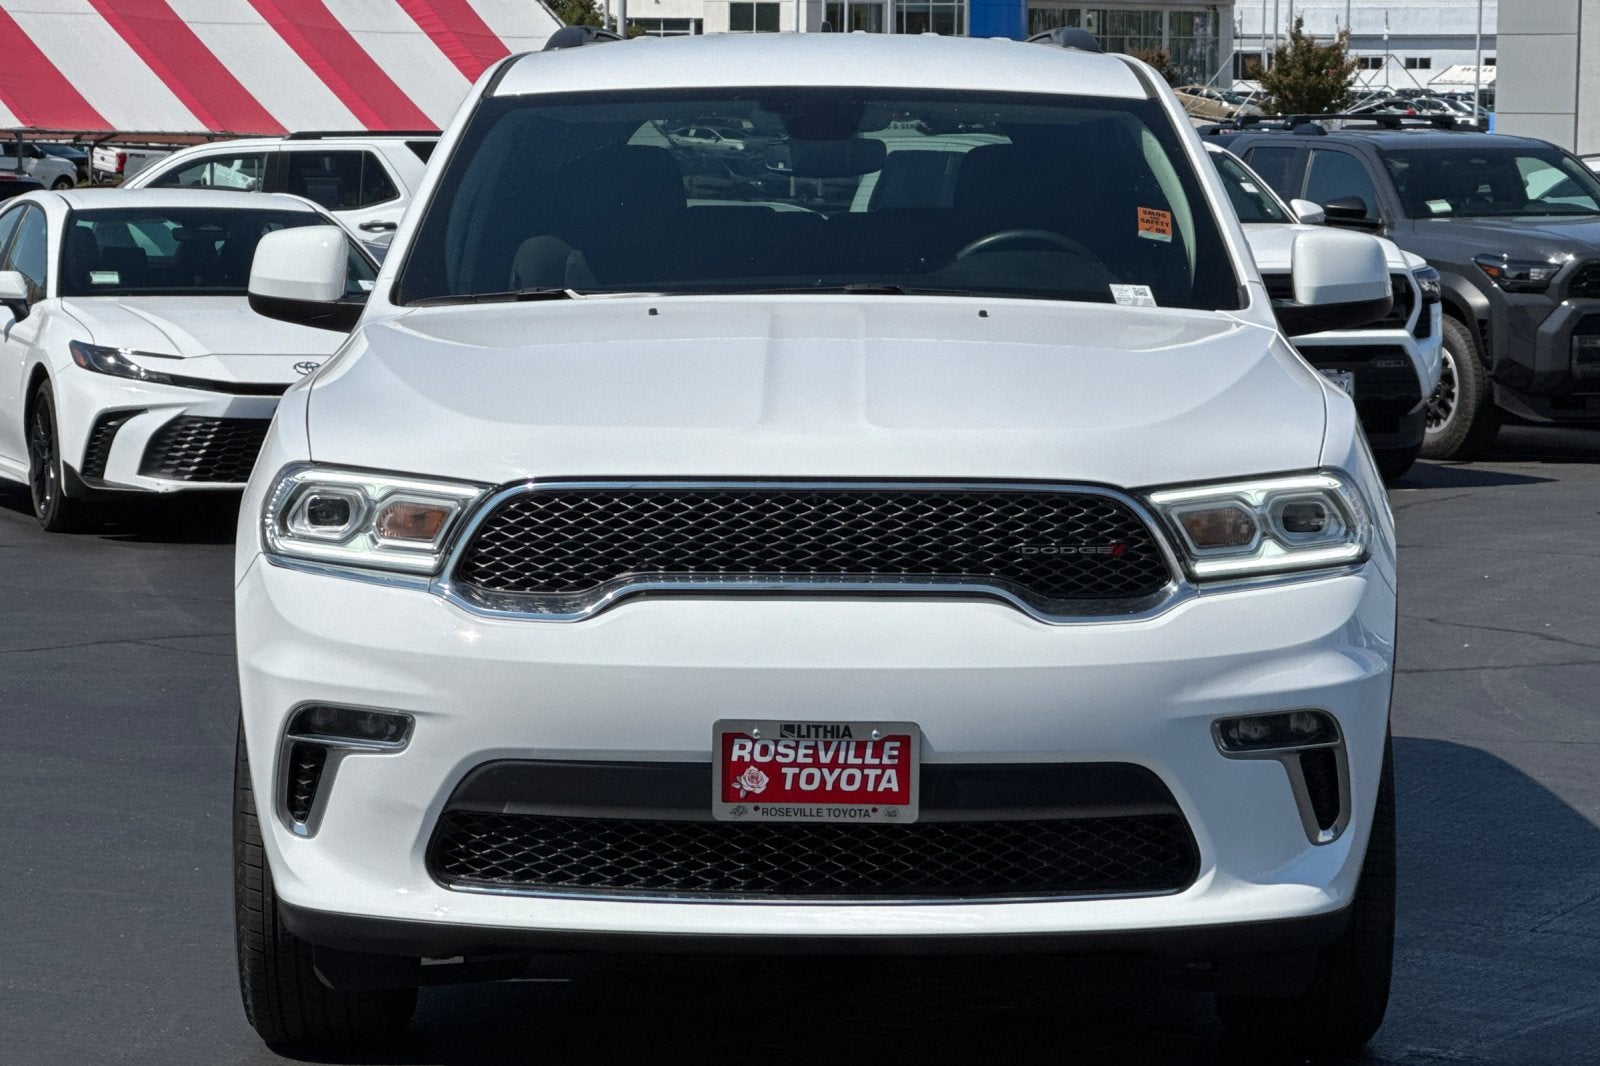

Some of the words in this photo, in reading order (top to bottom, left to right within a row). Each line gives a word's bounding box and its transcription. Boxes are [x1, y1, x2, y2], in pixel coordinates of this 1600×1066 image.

[1140, 218, 1169, 227] SAFETY
[1021, 546, 1113, 554] DODGE
[797, 724, 852, 739] LITHIA
[731, 738, 901, 765] ROSEVILLE
[781, 766, 899, 792] TOYOTA
[761, 807, 824, 818] ROSEVILLE
[826, 808, 871, 819] TOYOTA
